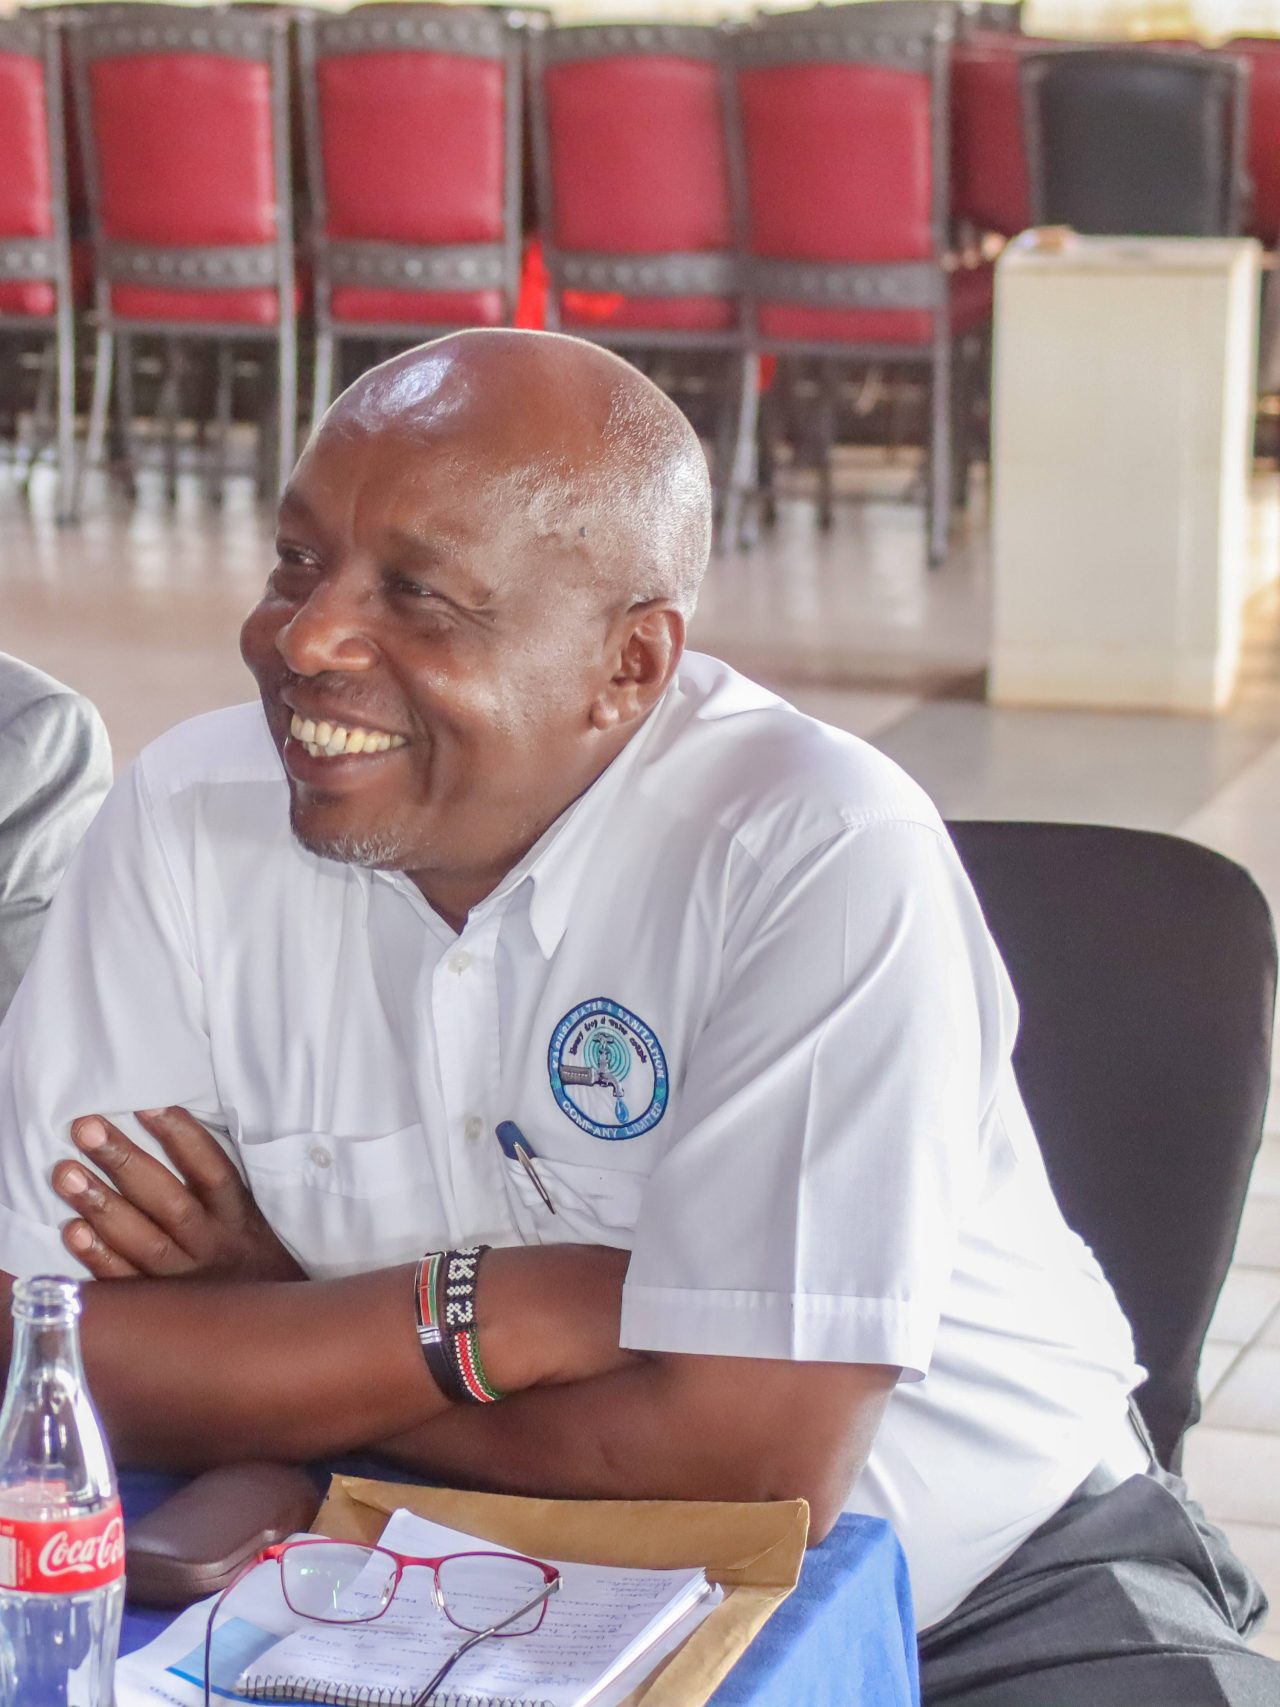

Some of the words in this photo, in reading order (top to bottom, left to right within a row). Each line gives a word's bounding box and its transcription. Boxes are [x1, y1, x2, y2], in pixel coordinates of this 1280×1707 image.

[618, 1008, 665, 1079] SANITATION
[562, 1100, 618, 1138] COMPANY
[625, 1102, 662, 1135] LIMITED
